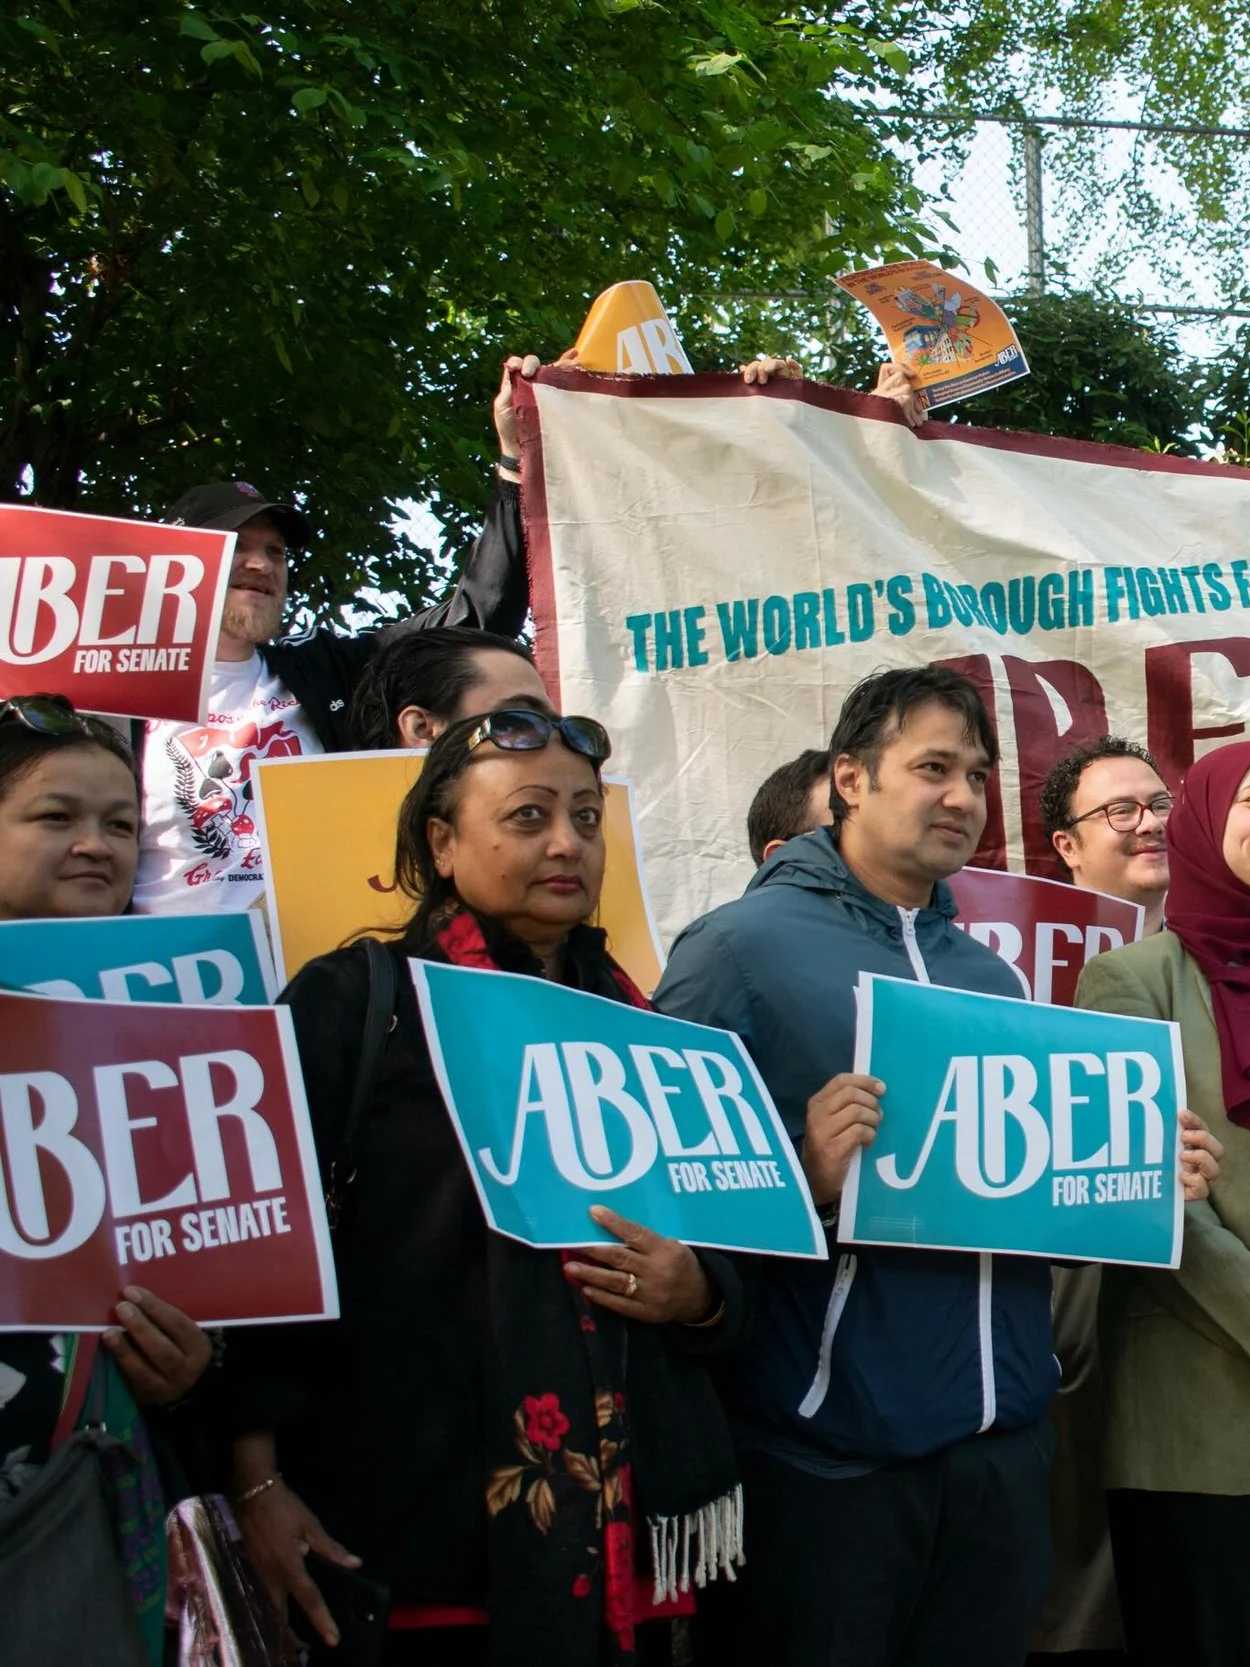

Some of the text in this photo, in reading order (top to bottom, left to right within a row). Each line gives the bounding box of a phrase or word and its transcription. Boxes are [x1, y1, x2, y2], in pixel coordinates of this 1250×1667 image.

[73, 647, 191, 673] FOR SENATE
[626, 605, 708, 673] THE
[717, 573, 916, 663] WORLD'S
[922, 569, 1094, 637] BOROUGH
[1105, 562, 1232, 623] FIGHTS
[0, 1050, 283, 1260] BER
[477, 1041, 773, 1191] ABER
[876, 1051, 1164, 1198] ABER
[667, 1160, 786, 1193] FOR SENATE
[1053, 1170, 1163, 1207] FOR SENATE
[114, 1197, 292, 1266] FOR SENATE
